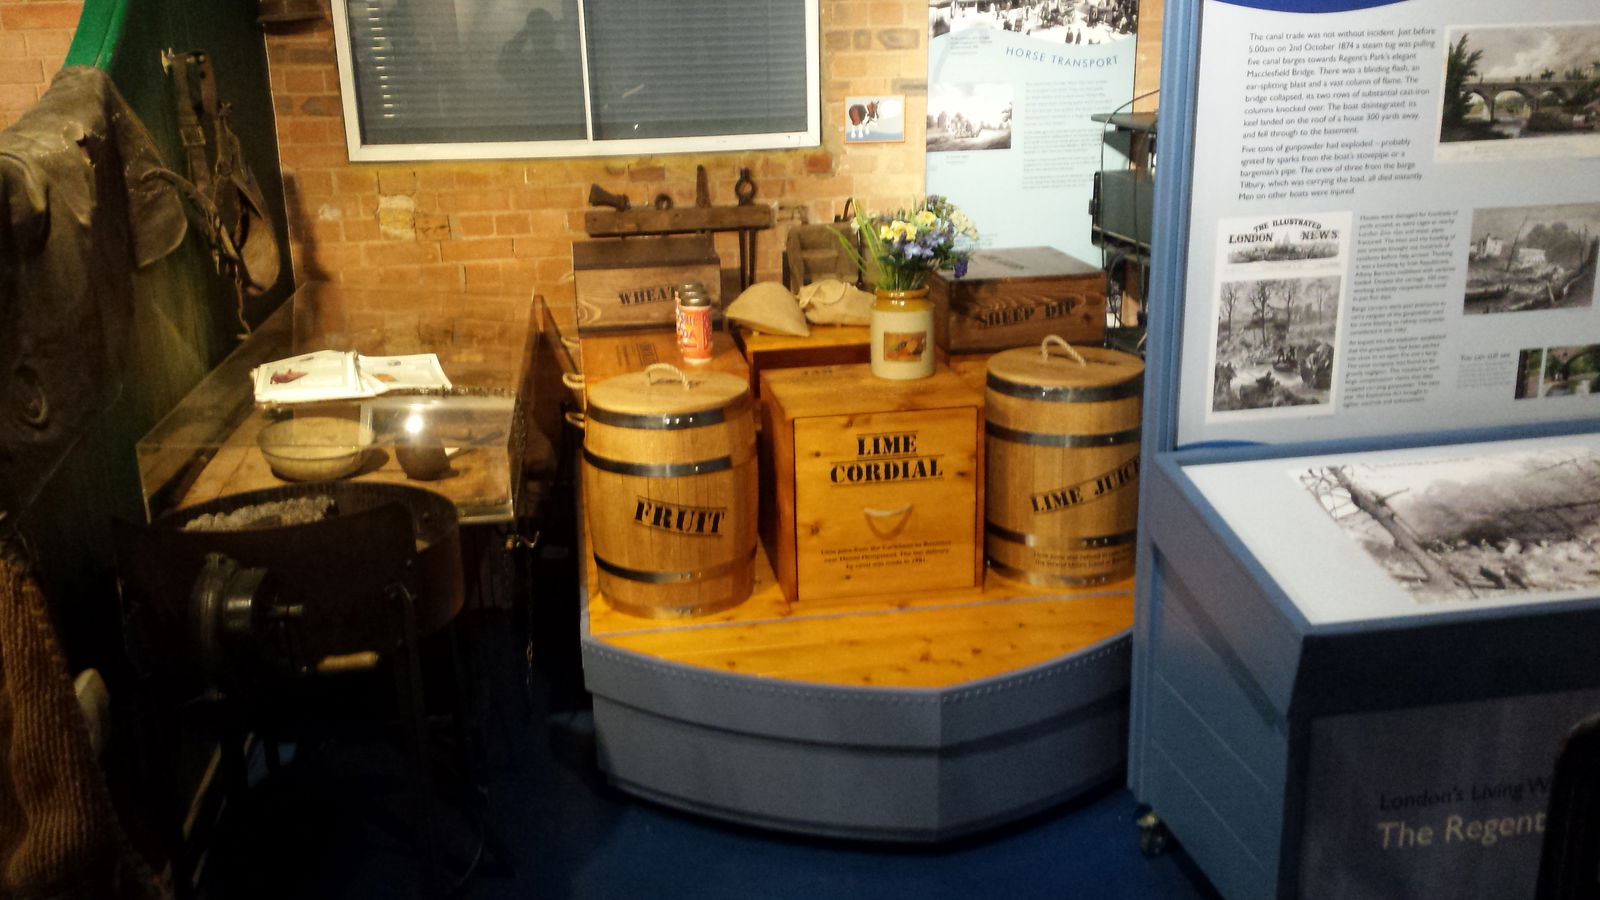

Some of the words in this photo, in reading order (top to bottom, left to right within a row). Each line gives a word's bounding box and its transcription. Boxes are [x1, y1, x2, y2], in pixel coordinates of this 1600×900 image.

[1250, 32, 1264, 40] The
[1338, 30, 1365, 38] without
[1398, 28, 1412, 37] Just
[1413, 26, 1436, 35] before
[1289, 44, 1303, 52] 2nd
[1385, 42, 1396, 50] tug
[1413, 40, 1436, 49] pulling
[1006, 46, 1046, 62] HORSE
[1052, 54, 1119, 69] TRANSPORT
[1283, 58, 1306, 66] barges
[1308, 55, 1336, 64] towards
[1392, 52, 1416, 62] elegant
[1246, 68, 1290, 78] Macclesfield
[1320, 66, 1340, 75] There
[1364, 66, 1390, 74] blinding
[1290, 81, 1306, 89] blast
[1346, 78, 1372, 86] column
[1406, 76, 1419, 84] The
[1245, 96, 1268, 104] bridge
[1362, 88, 1398, 97] substantial
[1276, 104, 1306, 113] knocked
[1328, 102, 1340, 110] The
[1368, 112, 1380, 120] 300
[1382, 112, 1400, 122] yards
[1242, 130, 1256, 139] and
[1270, 129, 1298, 138] through
[1242, 144, 1256, 152] Five
[1276, 144, 1283, 152] of
[1284, 142, 1324, 152] gunpowder
[1326, 141, 1339, 149] had
[1341, 140, 1373, 150] exploded
[1381, 138, 1411, 148] probably
[1240, 158, 1264, 166] ignited
[1266, 156, 1274, 165] by
[1277, 154, 1300, 165] sparks
[1302, 154, 1318, 162] from
[1356, 152, 1390, 160] stovepipe
[1344, 163, 1362, 171] three
[1397, 161, 1416, 170] barge
[1306, 178, 1334, 186] carrying
[1238, 192, 1254, 200] Men
[1254, 222, 1269, 233] THE
[1272, 218, 1322, 230] ILLUSTRATED
[1229, 232, 1273, 244] LONDON
[1301, 230, 1339, 240] NEWS
[974, 306, 1034, 327] SHEEP
[1045, 301, 1076, 318] DIP
[857, 434, 917, 456] LIME
[830, 458, 944, 483] CORDIAL
[1031, 487, 1084, 512] LIME
[635, 501, 725, 534] FRUIT
[1380, 785, 1464, 810] London's
[1472, 782, 1523, 800] Living
[1378, 822, 1433, 850] The
